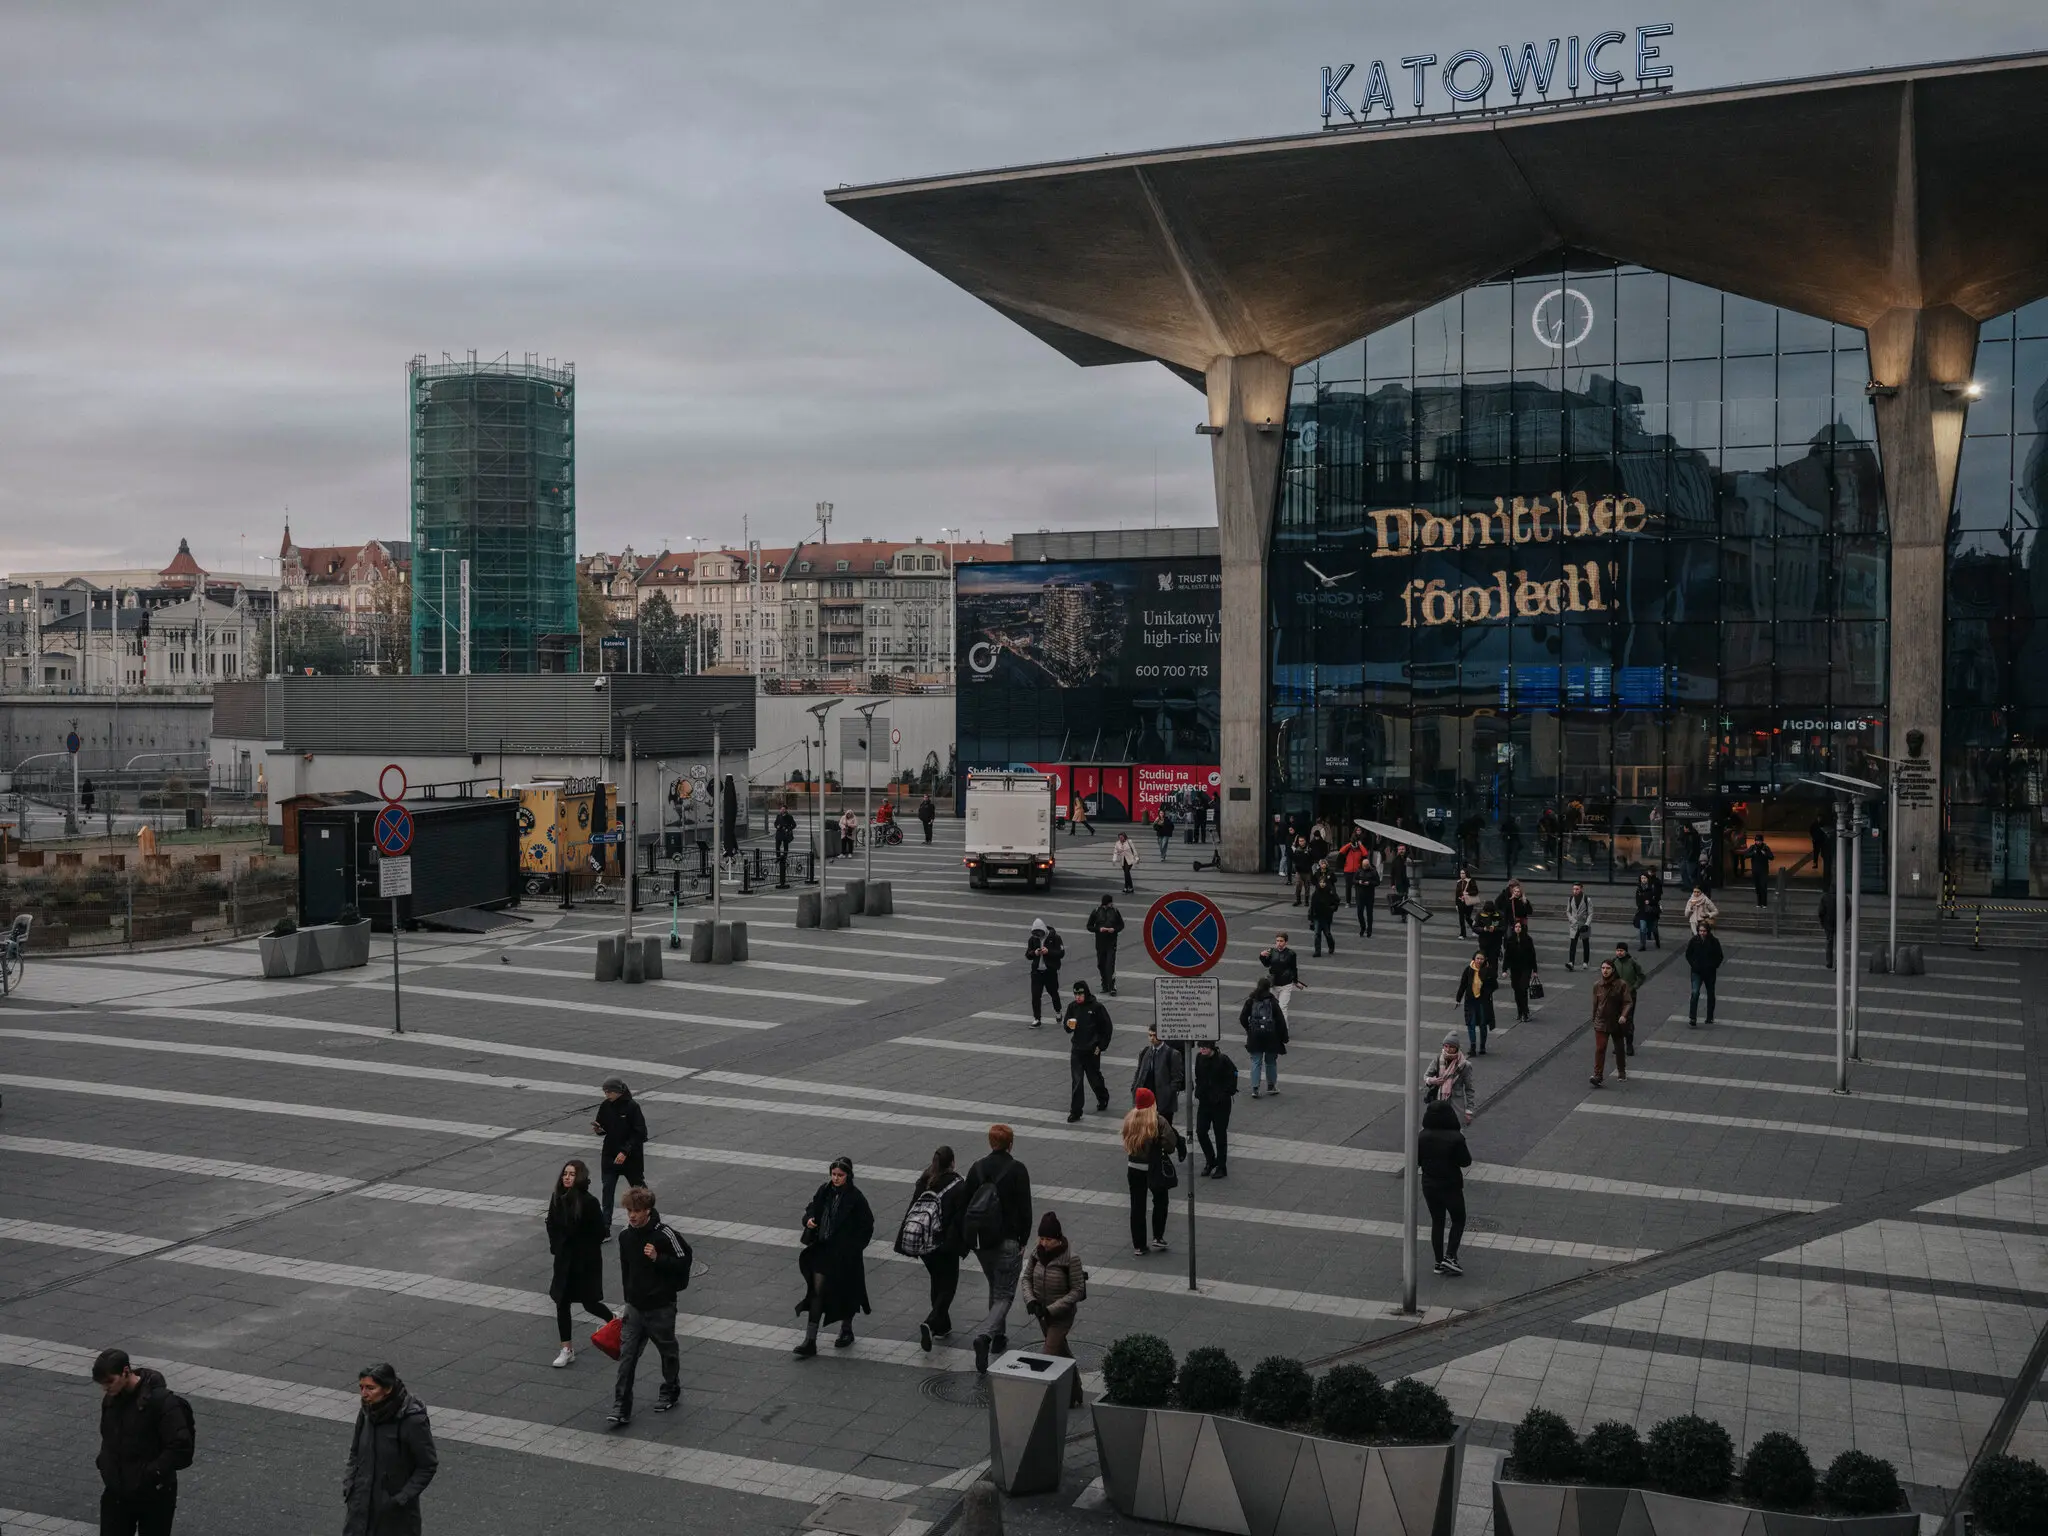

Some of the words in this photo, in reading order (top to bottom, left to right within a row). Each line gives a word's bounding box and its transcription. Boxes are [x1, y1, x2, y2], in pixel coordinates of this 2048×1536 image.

[1320, 23, 1673, 117] KATOWICE
[1178, 574, 1208, 584] TRUST
[1143, 609, 1214, 628] Unikatowy
[1143, 630, 1201, 648] high-rise
[1135, 665, 1160, 677] 600
[1162, 665, 1186, 676] 700
[1188, 665, 1208, 676] 713
[1782, 719, 1867, 730] McDonald's
[1139, 769, 1174, 782] Studiuj
[1176, 771, 1189, 780] na
[1139, 781, 1208, 793] Uniwersytecie
[1139, 791, 1177, 804] Śląskim
